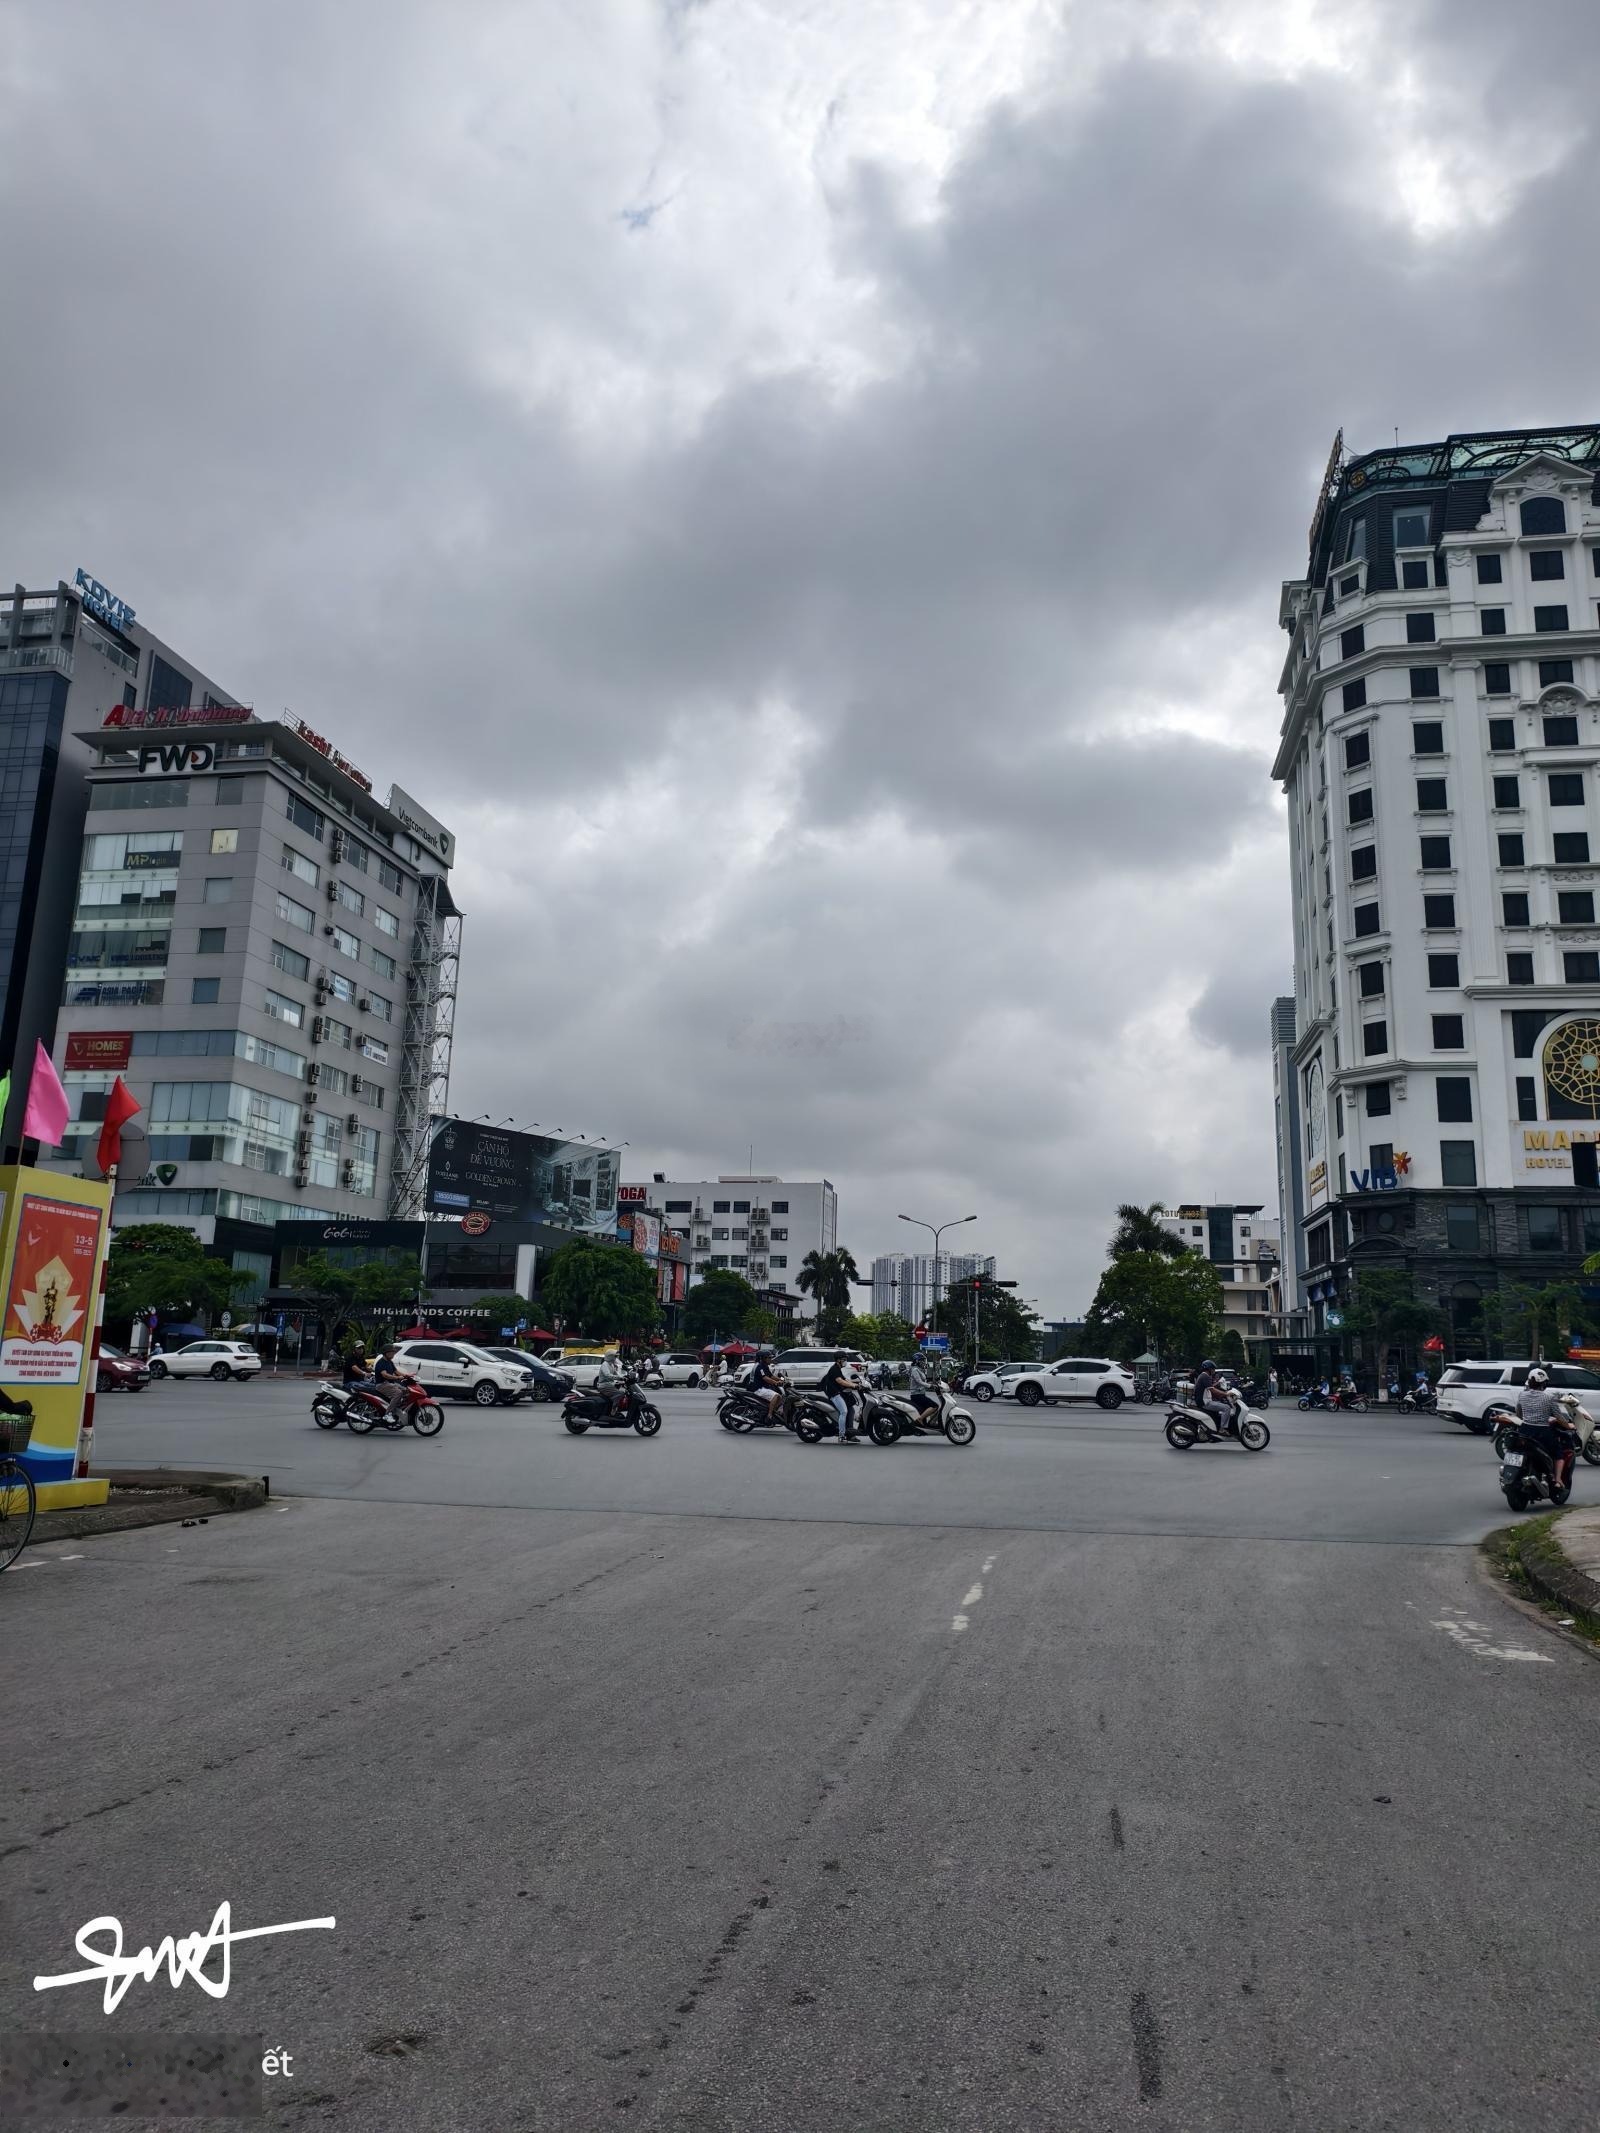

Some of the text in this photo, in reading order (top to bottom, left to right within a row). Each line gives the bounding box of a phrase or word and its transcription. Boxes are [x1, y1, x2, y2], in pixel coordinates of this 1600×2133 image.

[138, 744, 214, 773] FWD
[398, 806, 438, 849] Vietcombank
[87, 1040, 124, 1051] HOMES
[1526, 1157, 1571, 1168] HOTEL
[465, 1171, 493, 1183] GOLDEN
[1350, 1168, 1398, 1192] VIB
[75, 1235, 94, 1246] 13-5
[373, 1307, 491, 1317] HIGHLANDS COFFEE
